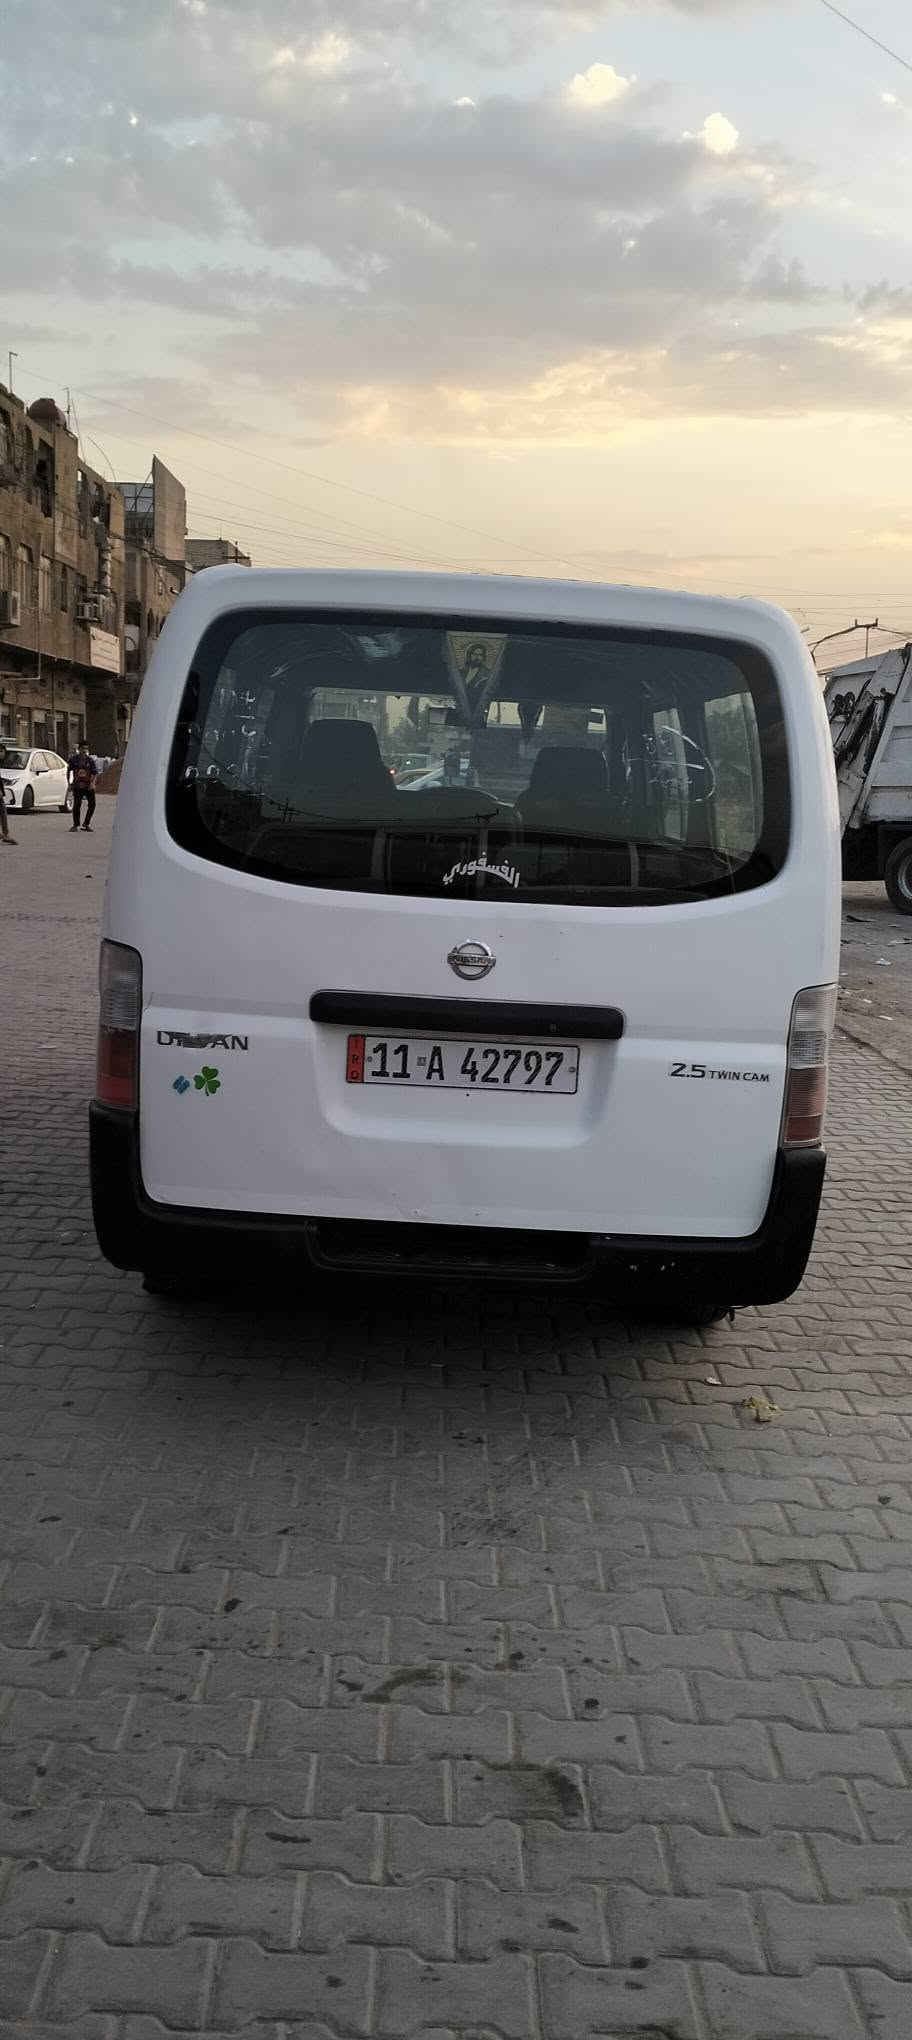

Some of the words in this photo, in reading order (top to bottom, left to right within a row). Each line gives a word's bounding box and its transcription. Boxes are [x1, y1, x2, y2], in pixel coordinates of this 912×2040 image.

[371, 1042, 411, 1079] 11
[425, 1045, 445, 1081] A
[460, 1047, 564, 1086] 42797
[670, 1062, 707, 1079] 2.5
[708, 1070, 740, 1081] TWIN
[742, 1072, 770, 1082] CAM
